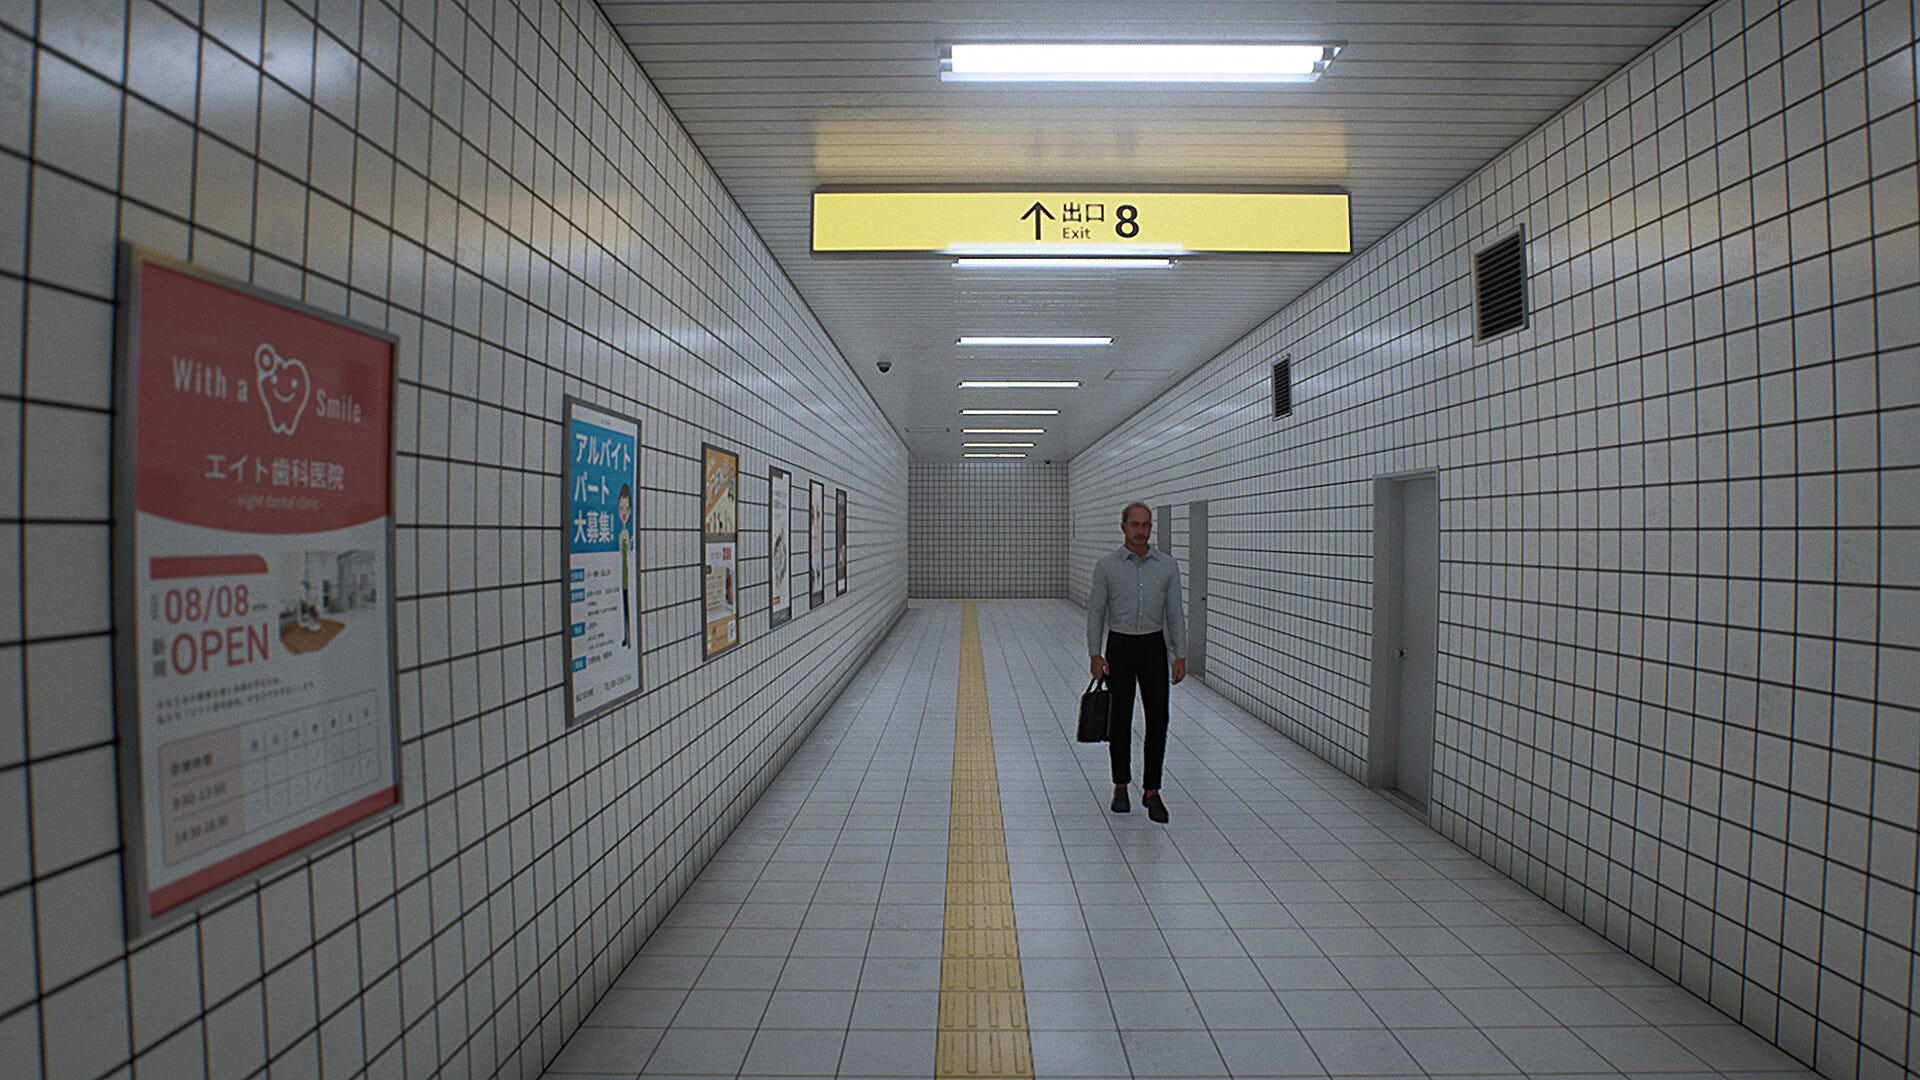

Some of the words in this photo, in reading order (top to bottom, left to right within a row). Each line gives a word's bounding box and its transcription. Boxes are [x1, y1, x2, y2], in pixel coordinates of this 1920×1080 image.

[1062, 201, 1105, 223] 出口
[1115, 204, 1140, 239] 8
[1062, 226, 1091, 239] Exit
[171, 355, 228, 400] With
[236, 378, 249, 402] a
[315, 387, 362, 424] Smile
[575, 431, 631, 472] アルバイト
[204, 453, 345, 491] エイト歯科医院
[574, 471, 610, 505] パート
[573, 509, 614, 544] 大募集!
[164, 584, 250, 625] 08/08
[171, 622, 270, 676] OPEN
